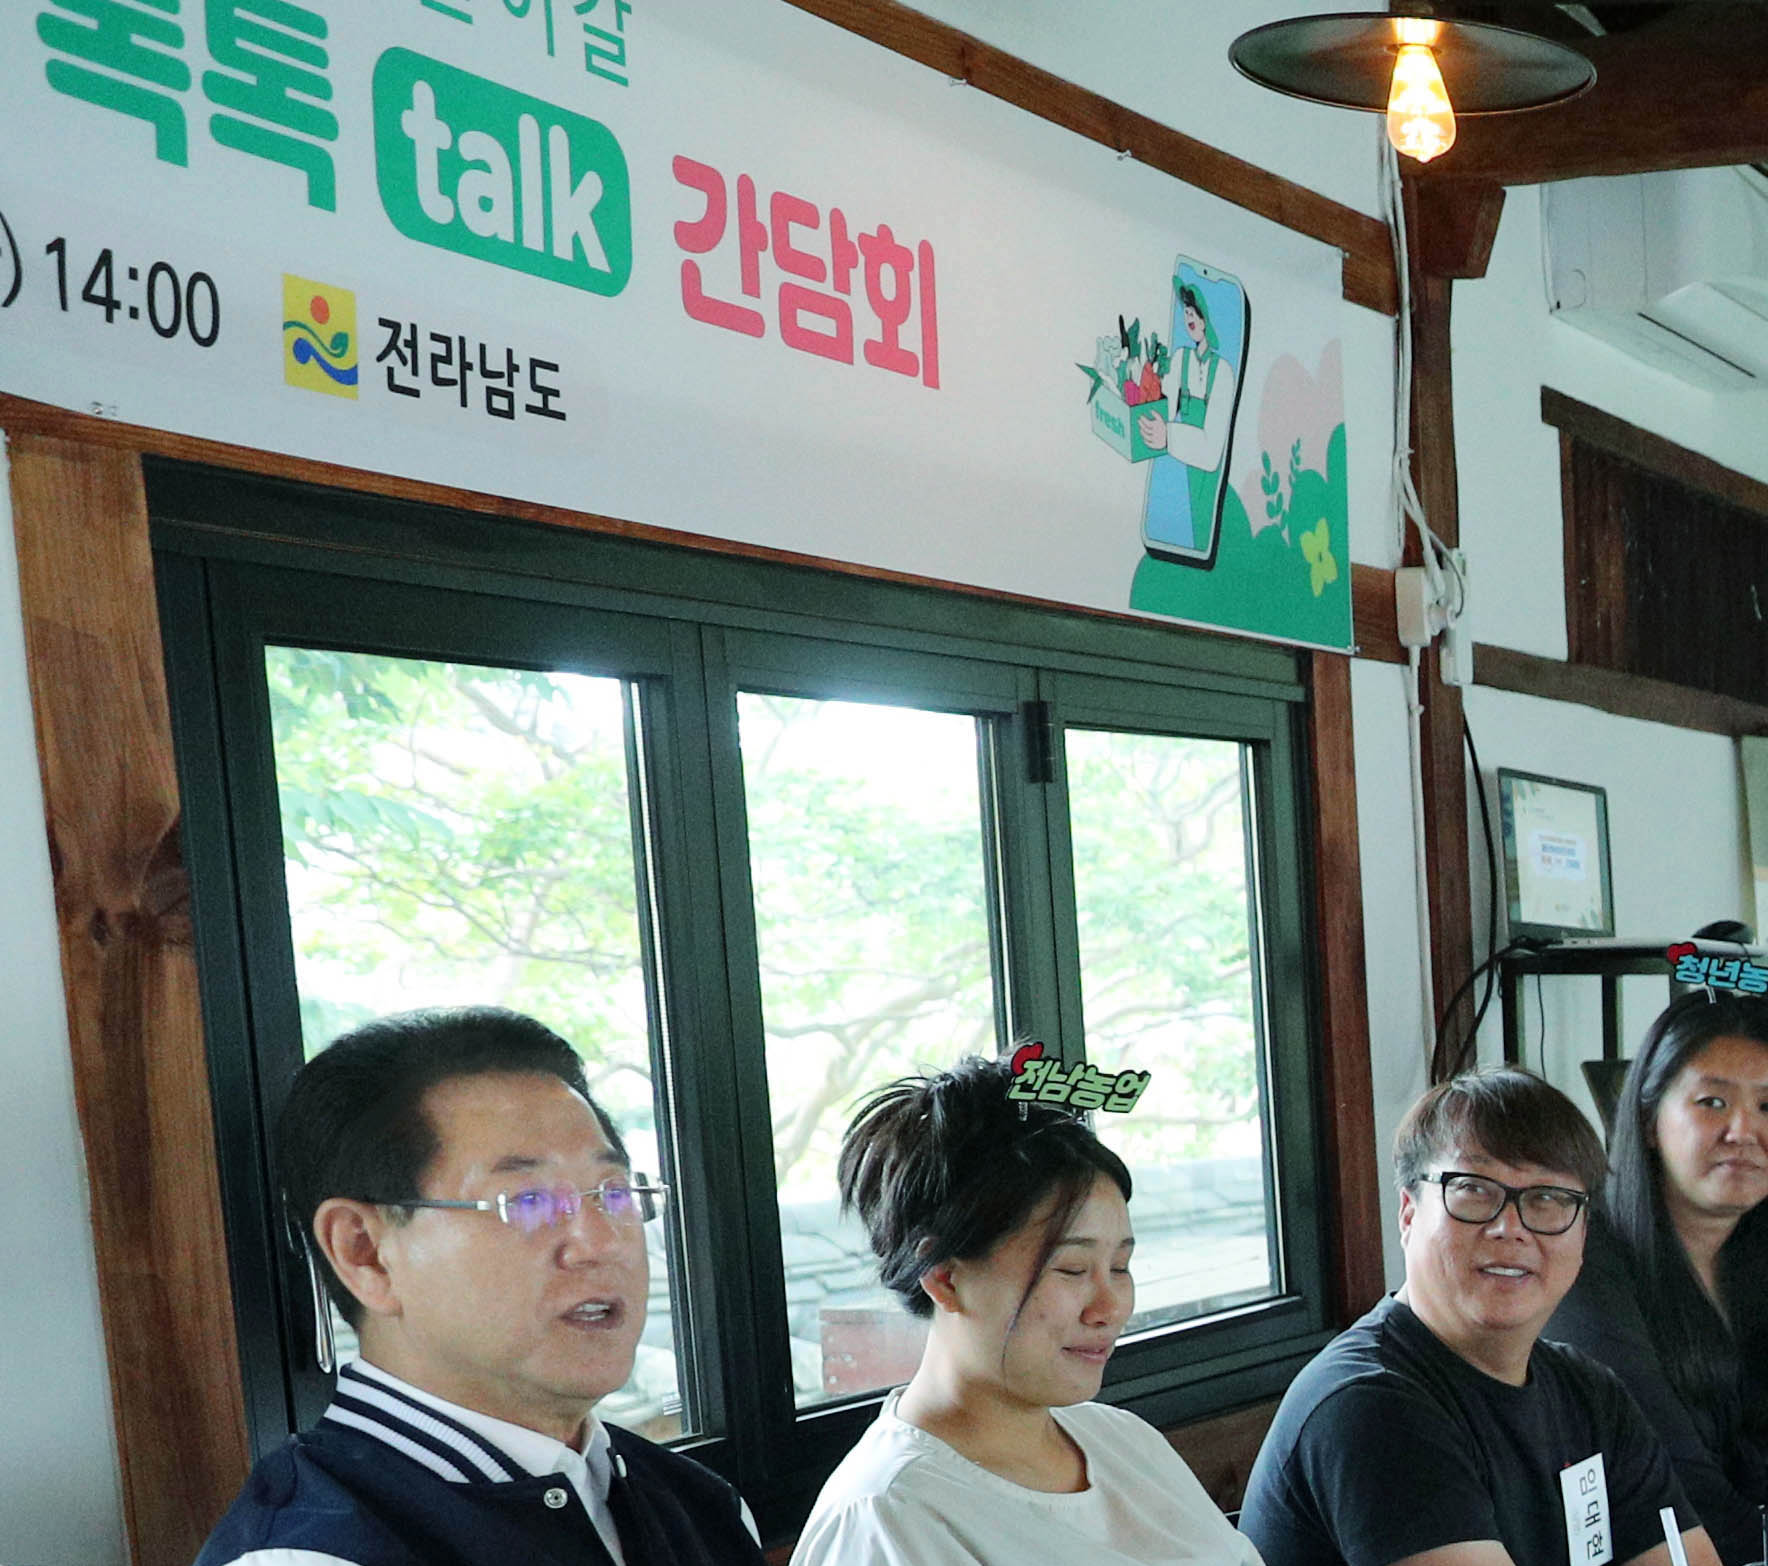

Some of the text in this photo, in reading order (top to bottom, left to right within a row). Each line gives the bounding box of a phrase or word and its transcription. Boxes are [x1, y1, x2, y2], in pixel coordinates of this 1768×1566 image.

[401, 79, 612, 274] talk
[672, 154, 940, 390] 간담회
[45, 236, 220, 348] 14:00
[375, 315, 568, 423] 전라남도
[1095, 400, 1126, 438] fresh
[1007, 1059, 1152, 1113] 전남농업
[1579, 1468, 1605, 1561] 임대현
